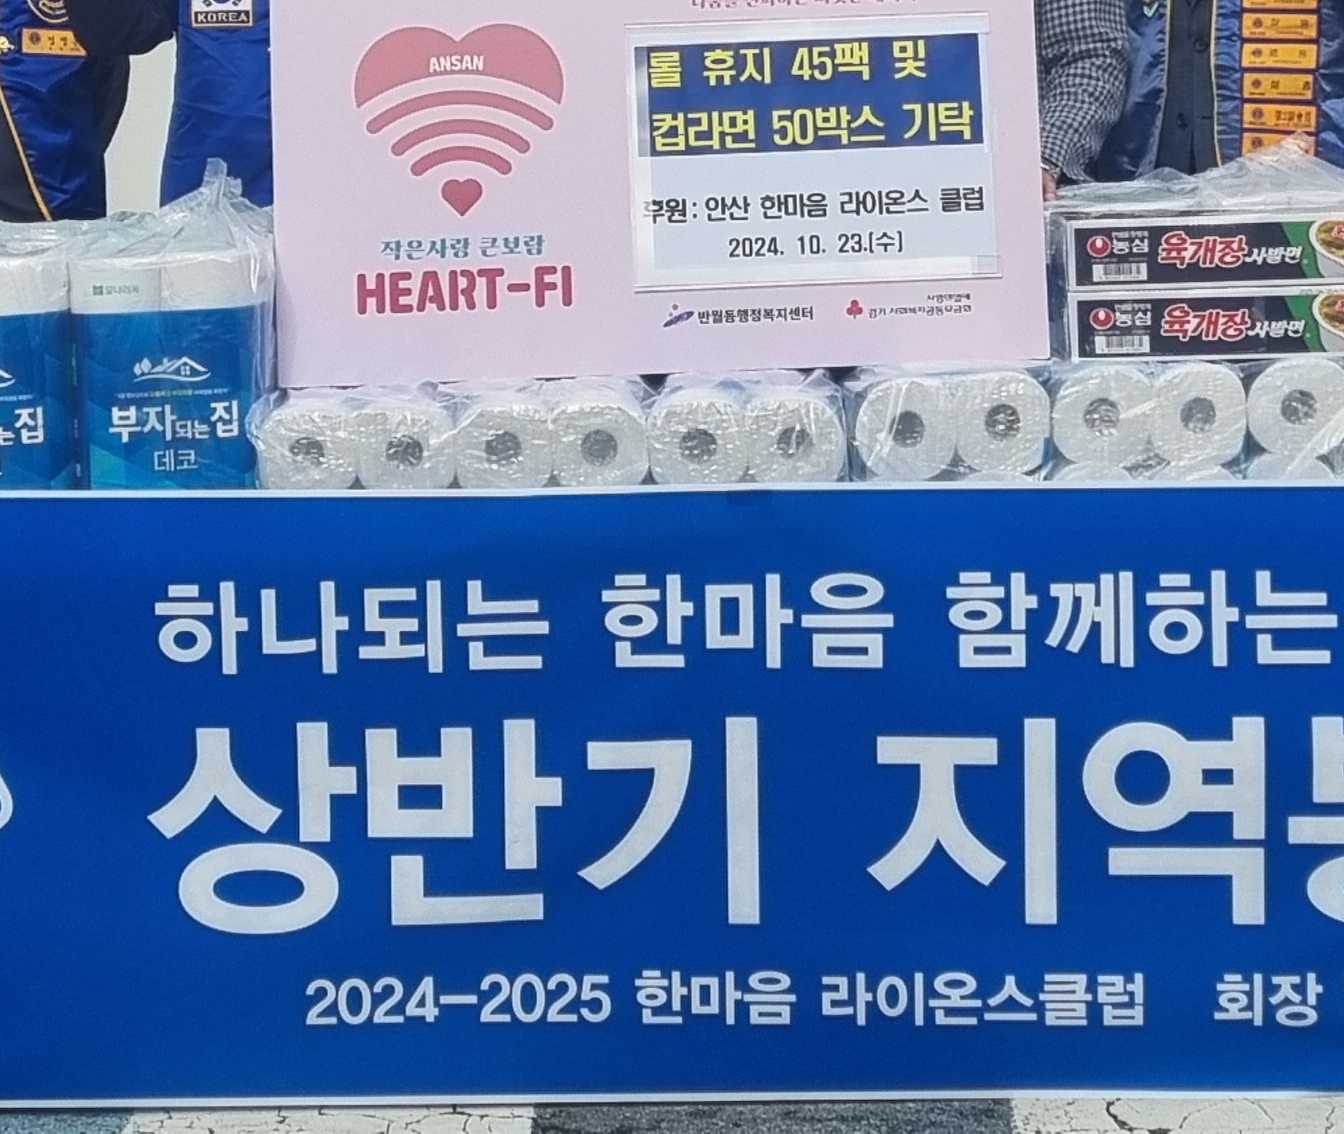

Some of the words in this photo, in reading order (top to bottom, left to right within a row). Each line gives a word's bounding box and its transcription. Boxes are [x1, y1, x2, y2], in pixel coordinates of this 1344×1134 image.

[197, 11, 249, 24] KOREA
[428, 53, 485, 74] ANSAN
[649, 51, 682, 88] 롤
[703, 47, 772, 85] 휴지
[791, 41, 871, 82] 45팩
[892, 38, 927, 79] 및
[651, 109, 757, 154] 컵라면
[772, 103, 886, 149] 50박스
[903, 99, 975, 143] 기탁
[705, 196, 751, 223] 안산
[760, 192, 828, 220] 한마음
[840, 188, 930, 217] 라이온스
[939, 186, 985, 212] 클럽
[728, 235, 785, 259] 2024.
[797, 233, 826, 255] 10.
[1113, 235, 1149, 255] 농심
[1157, 231, 1248, 268] 육개장
[356, 264, 575, 316] HEART-FI
[109, 402, 240, 444] 부자되는집
[154, 450, 199, 473] 데코
[157, 577, 550, 674] 하나되는
[602, 571, 895, 669] 한마음
[945, 567, 1340, 668] 함께하는
[147, 712, 763, 934] 상반기
[306, 974, 612, 1026] 2024-2025
[634, 969, 797, 1026] 한마음
[820, 969, 1147, 1027] 라이온스클럽
[1214, 969, 1322, 1026] 회장
